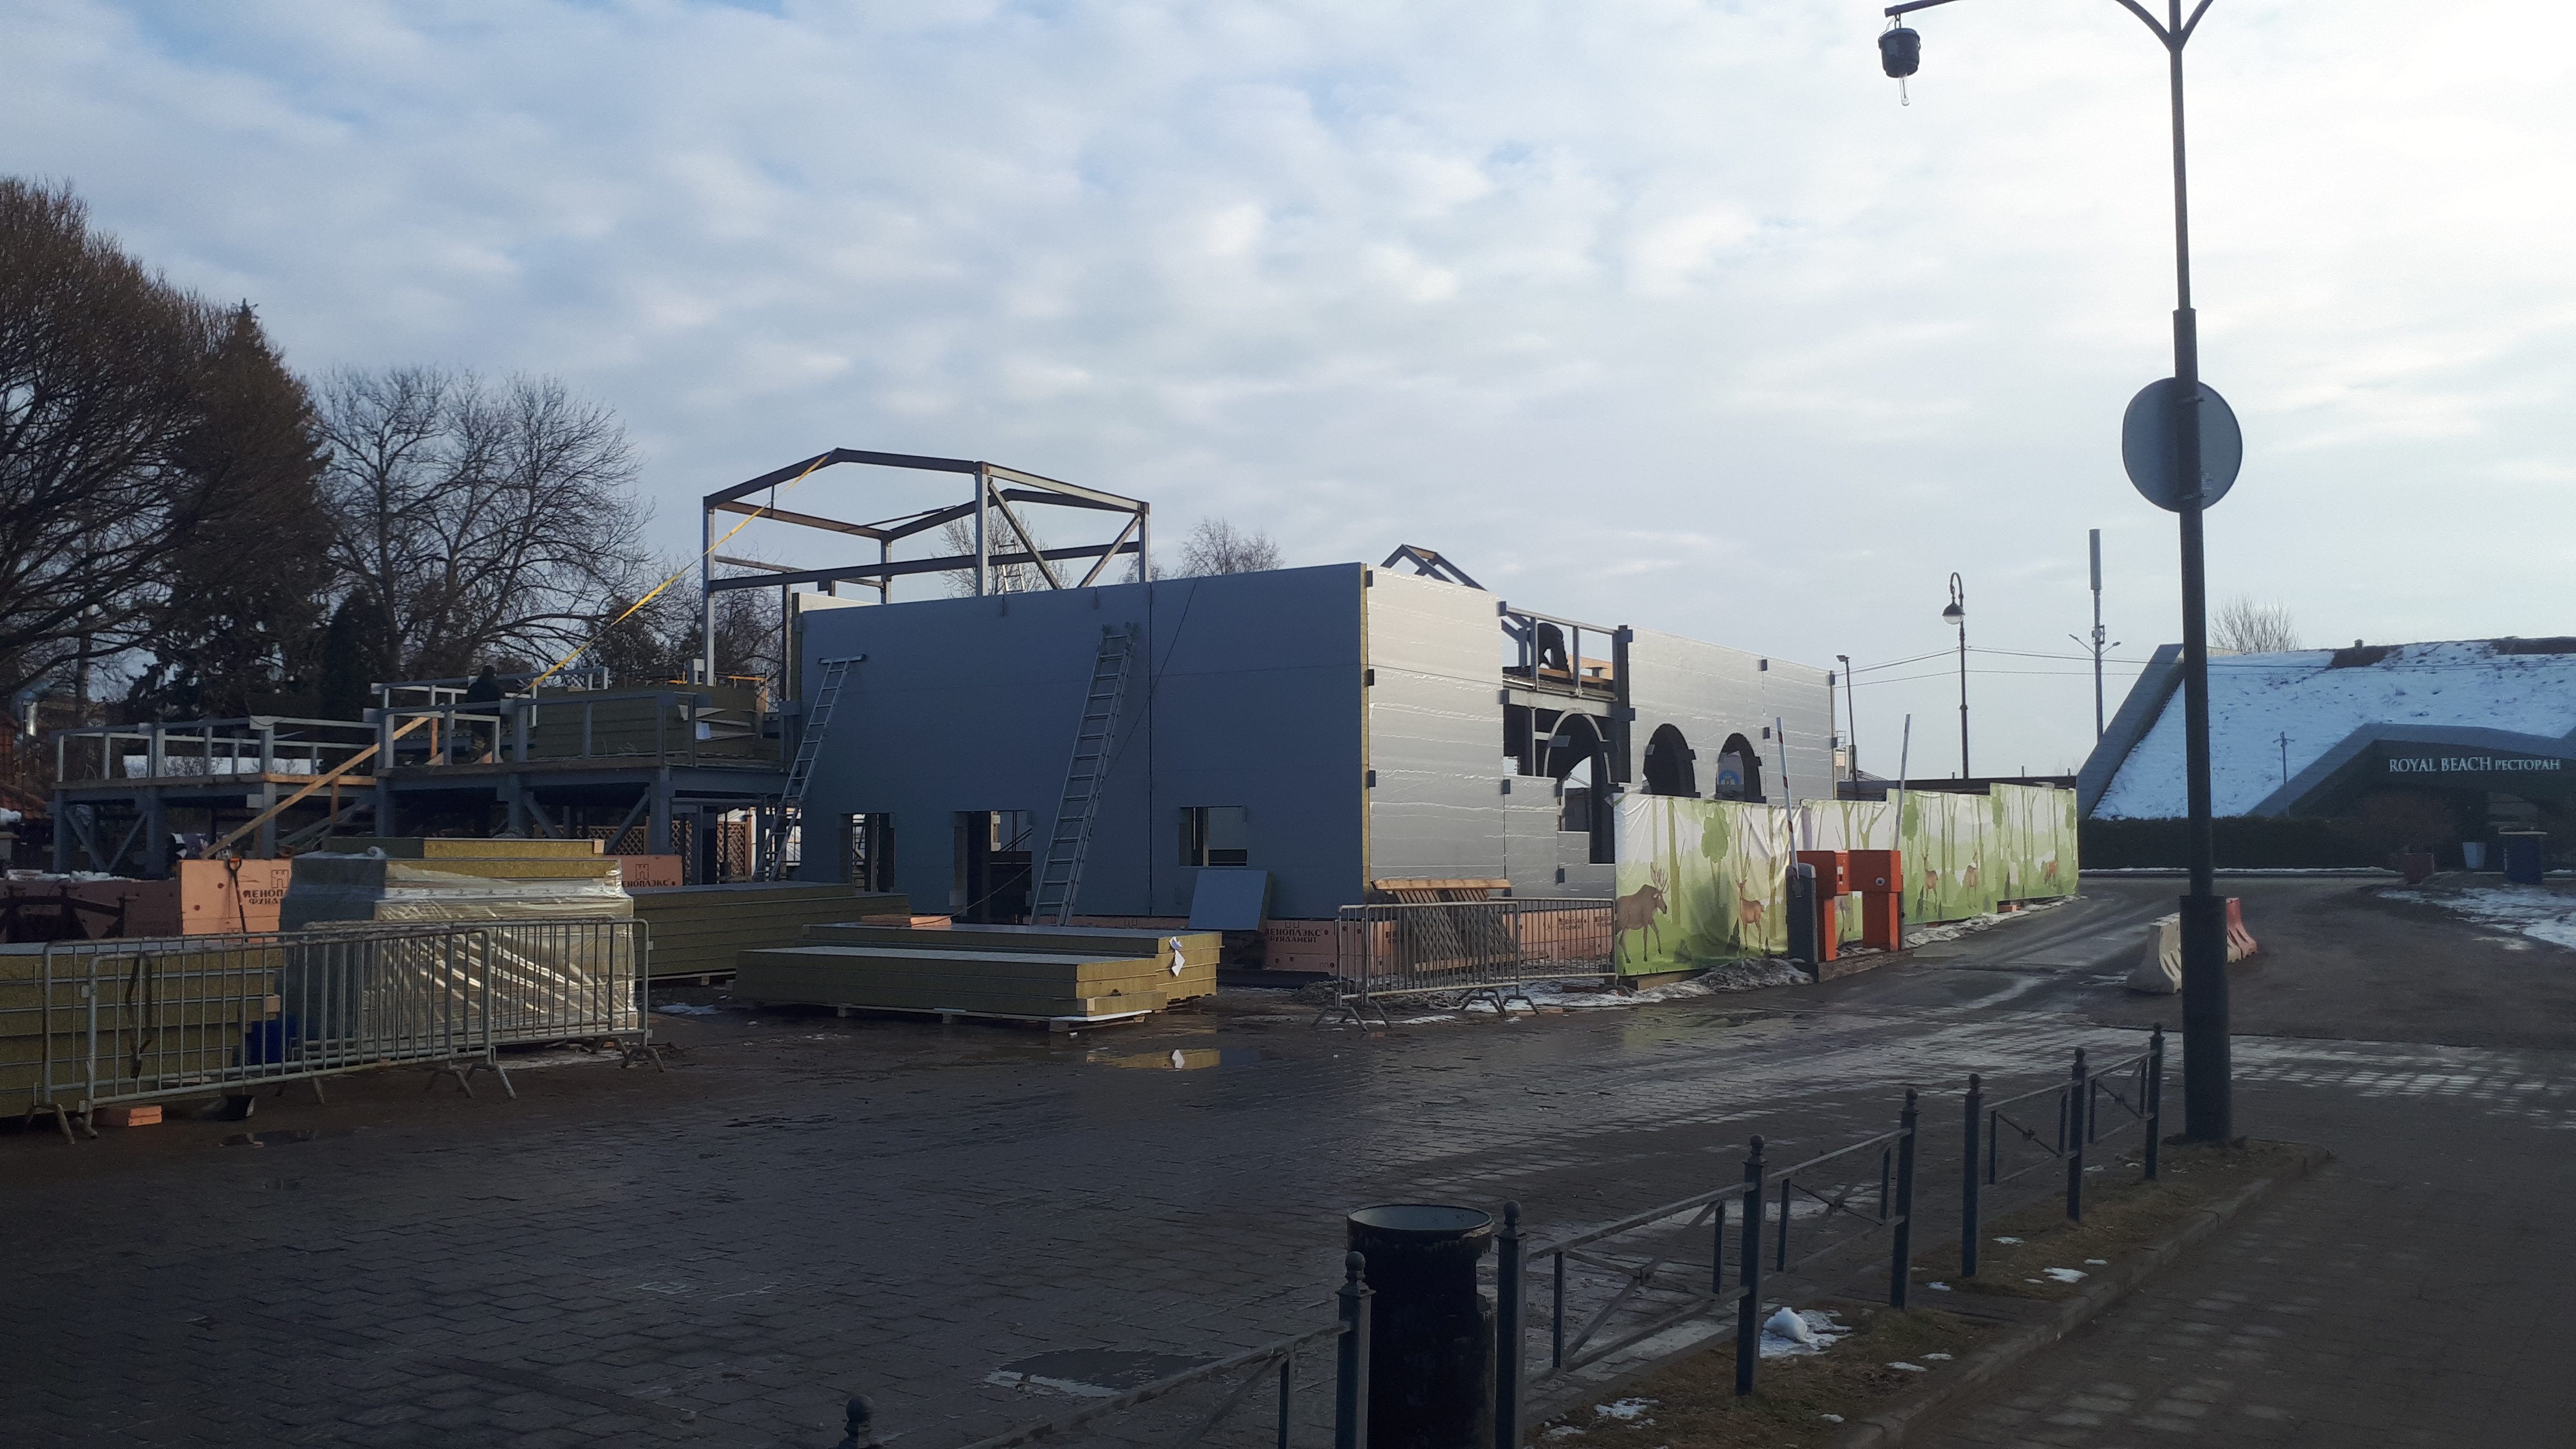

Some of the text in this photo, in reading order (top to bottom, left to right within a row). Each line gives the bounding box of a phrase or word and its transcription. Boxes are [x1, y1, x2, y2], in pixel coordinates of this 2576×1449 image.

[2389, 756, 2561, 772] ROYAL BEACH РЕСТОРАН
